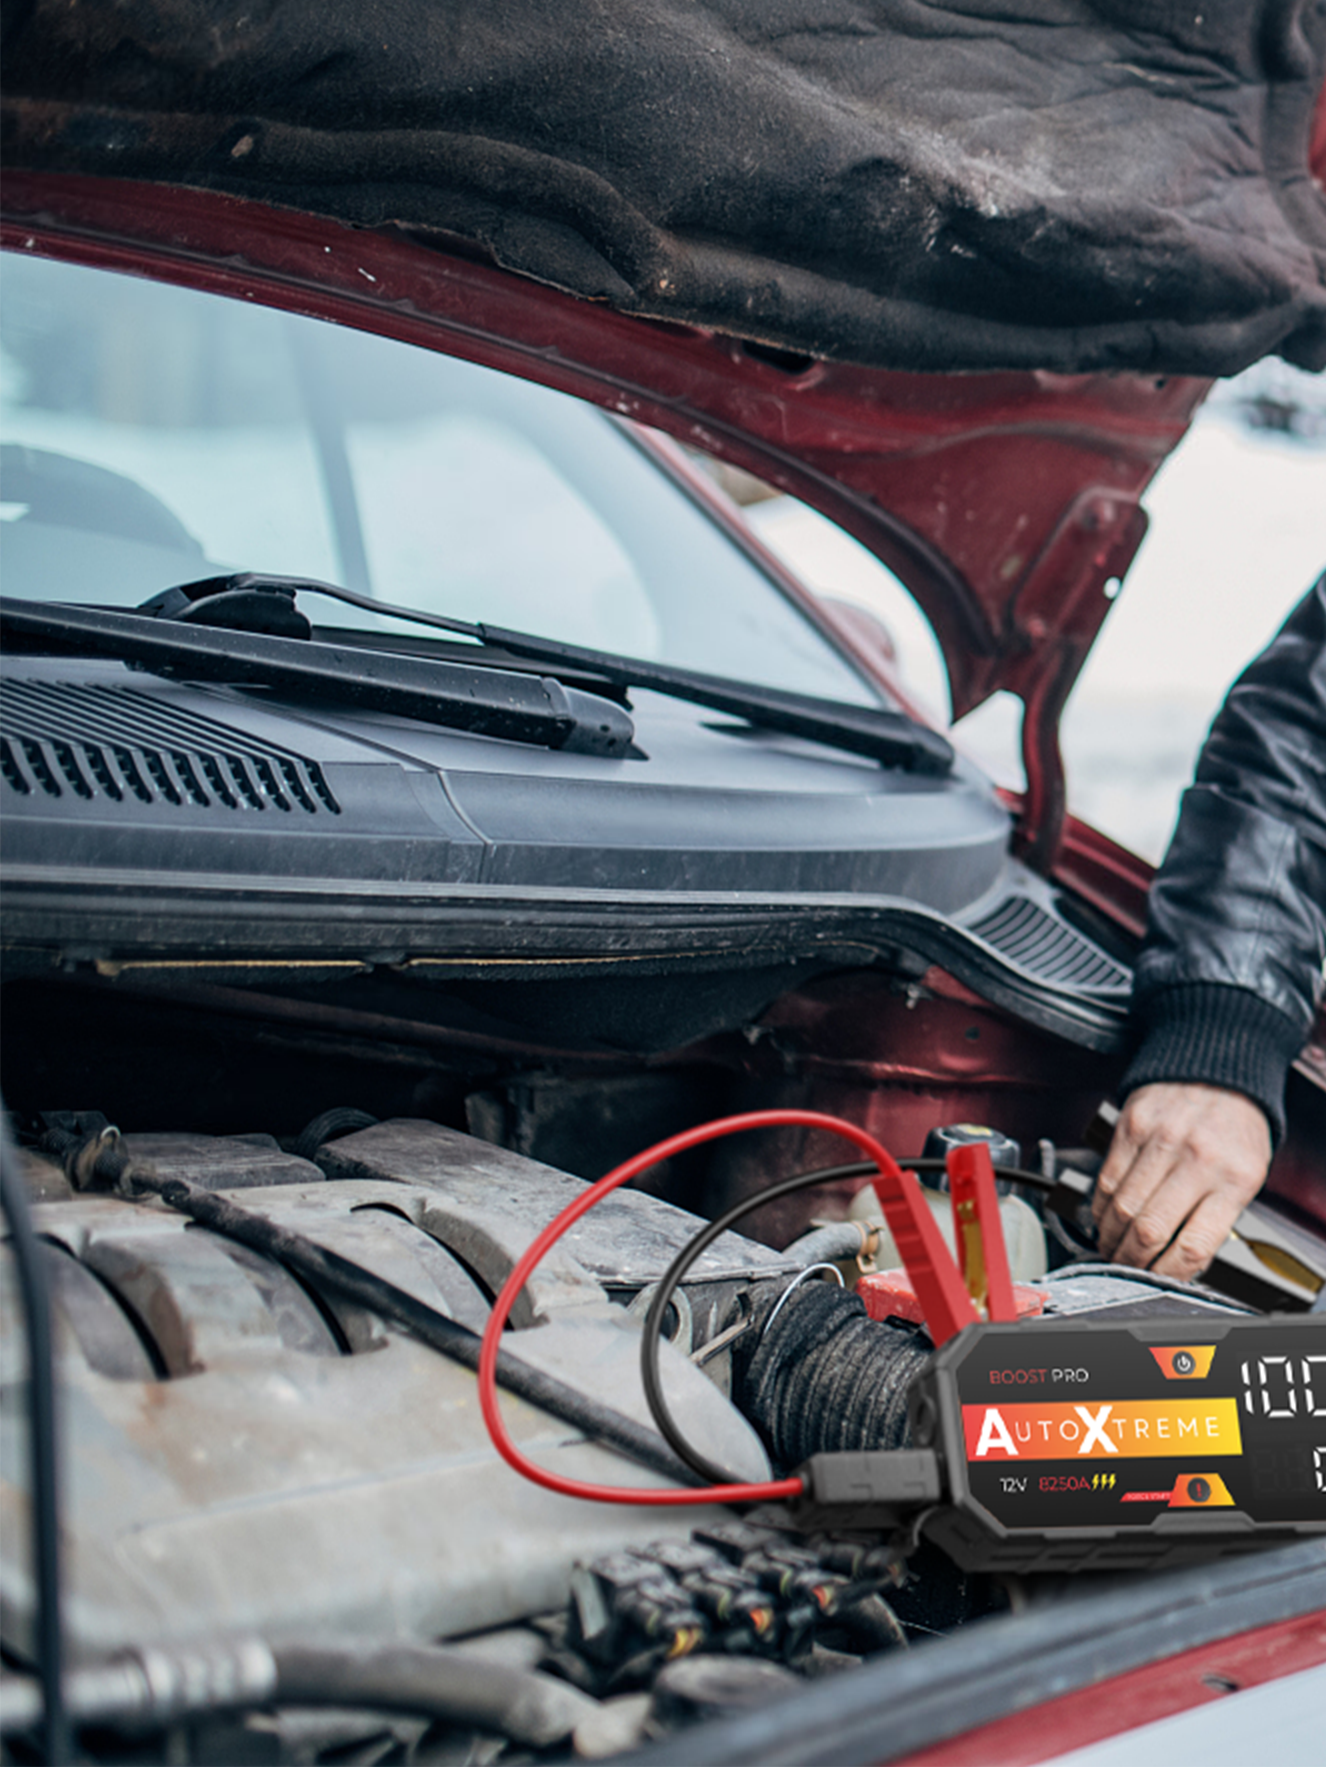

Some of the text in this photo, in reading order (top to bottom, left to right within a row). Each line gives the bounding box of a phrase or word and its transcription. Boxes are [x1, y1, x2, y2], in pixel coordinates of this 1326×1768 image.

[988, 1367, 1090, 1385] BOOST PRO
[999, 1475, 1091, 1493] 12V 8250A
